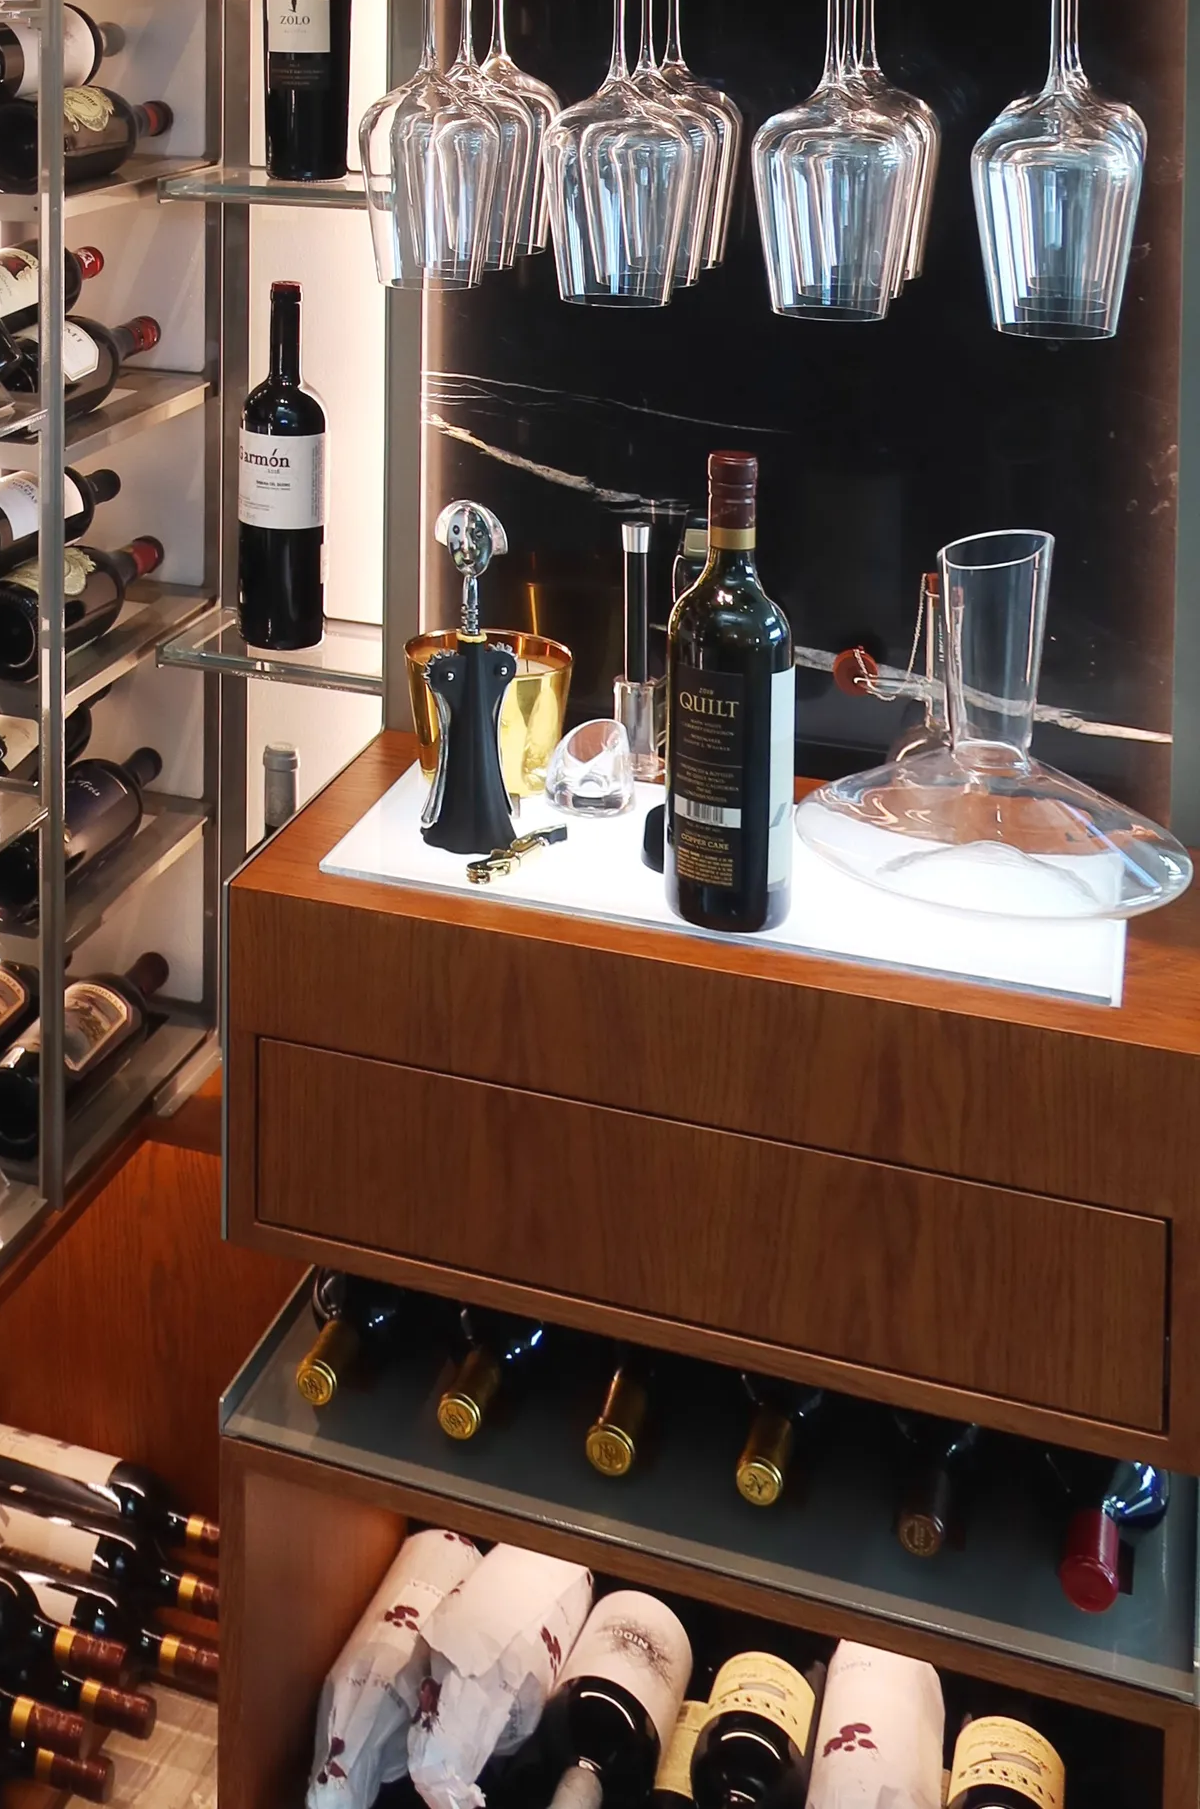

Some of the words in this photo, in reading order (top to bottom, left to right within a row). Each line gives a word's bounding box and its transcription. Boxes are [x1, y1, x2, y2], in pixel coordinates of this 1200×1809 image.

[279, 15, 311, 26] ZOLO
[679, 691, 740, 719] QUILT
[707, 840, 730, 851] CANE
